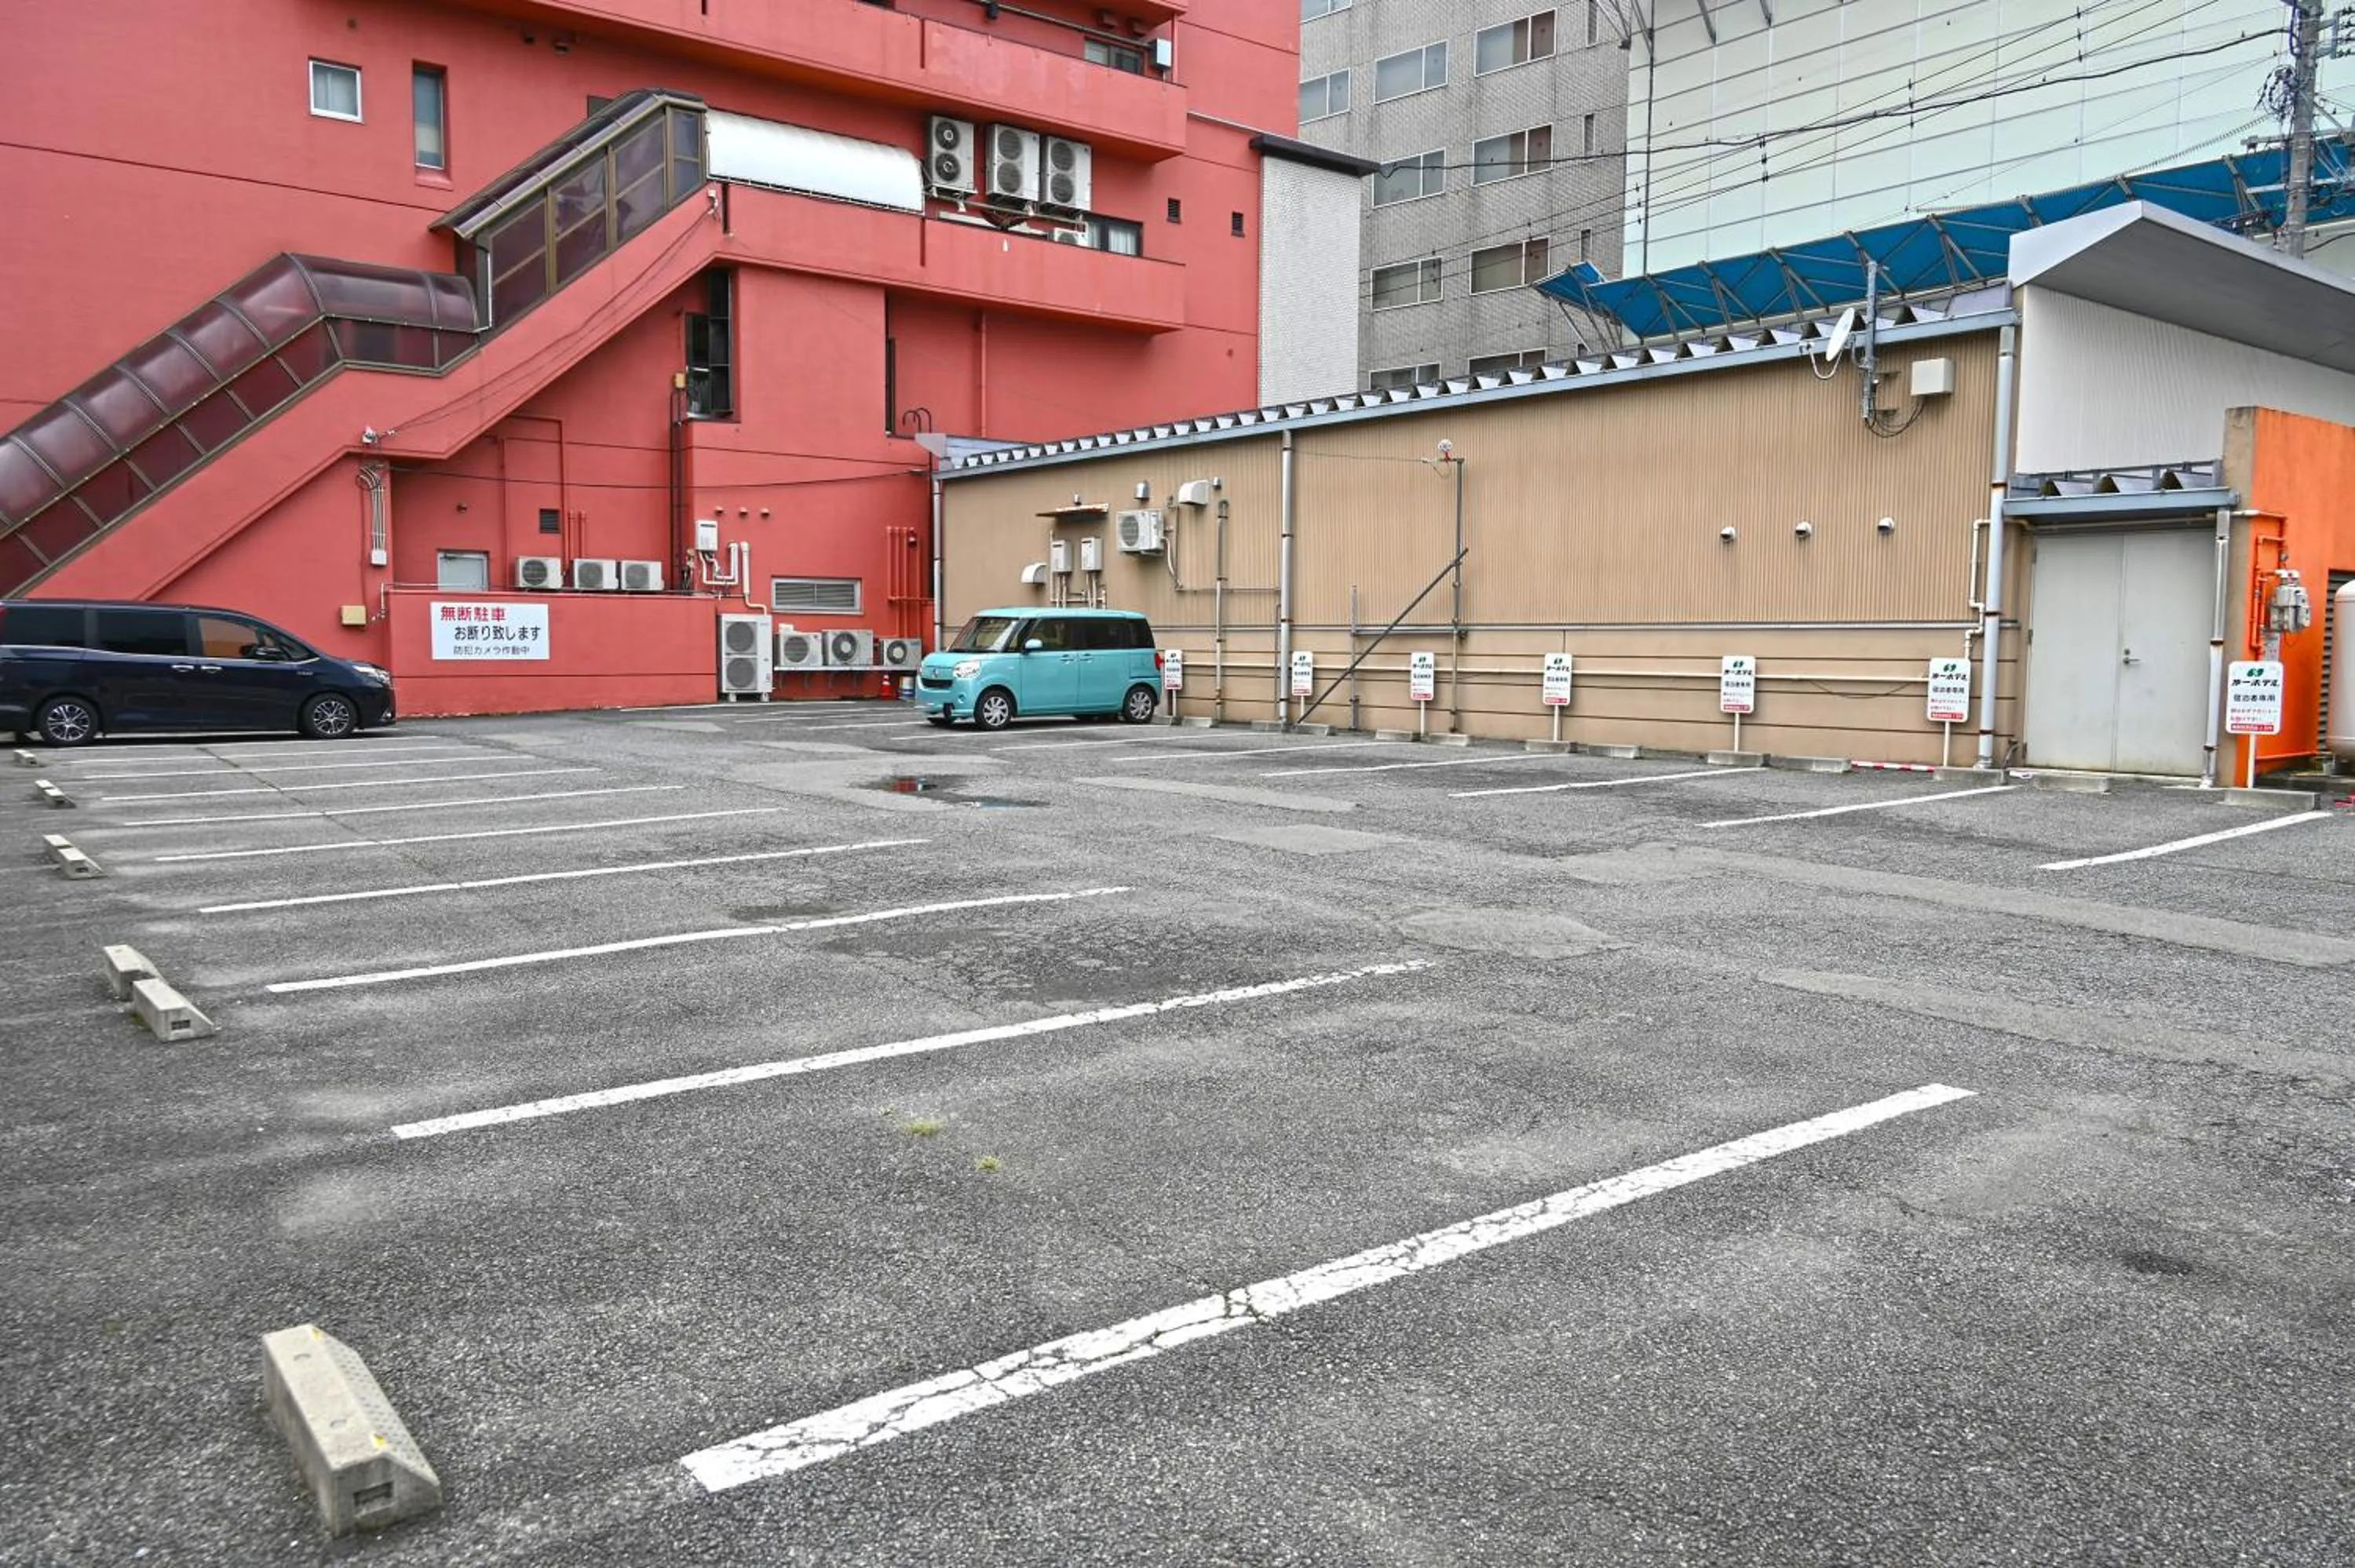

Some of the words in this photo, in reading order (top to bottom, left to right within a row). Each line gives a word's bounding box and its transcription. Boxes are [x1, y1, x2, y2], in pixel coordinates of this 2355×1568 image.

[440, 606, 507, 622] 無断駐車
[454, 625, 541, 641] お断り致します
[453, 645, 530, 656] 防犯カメラ作動中
